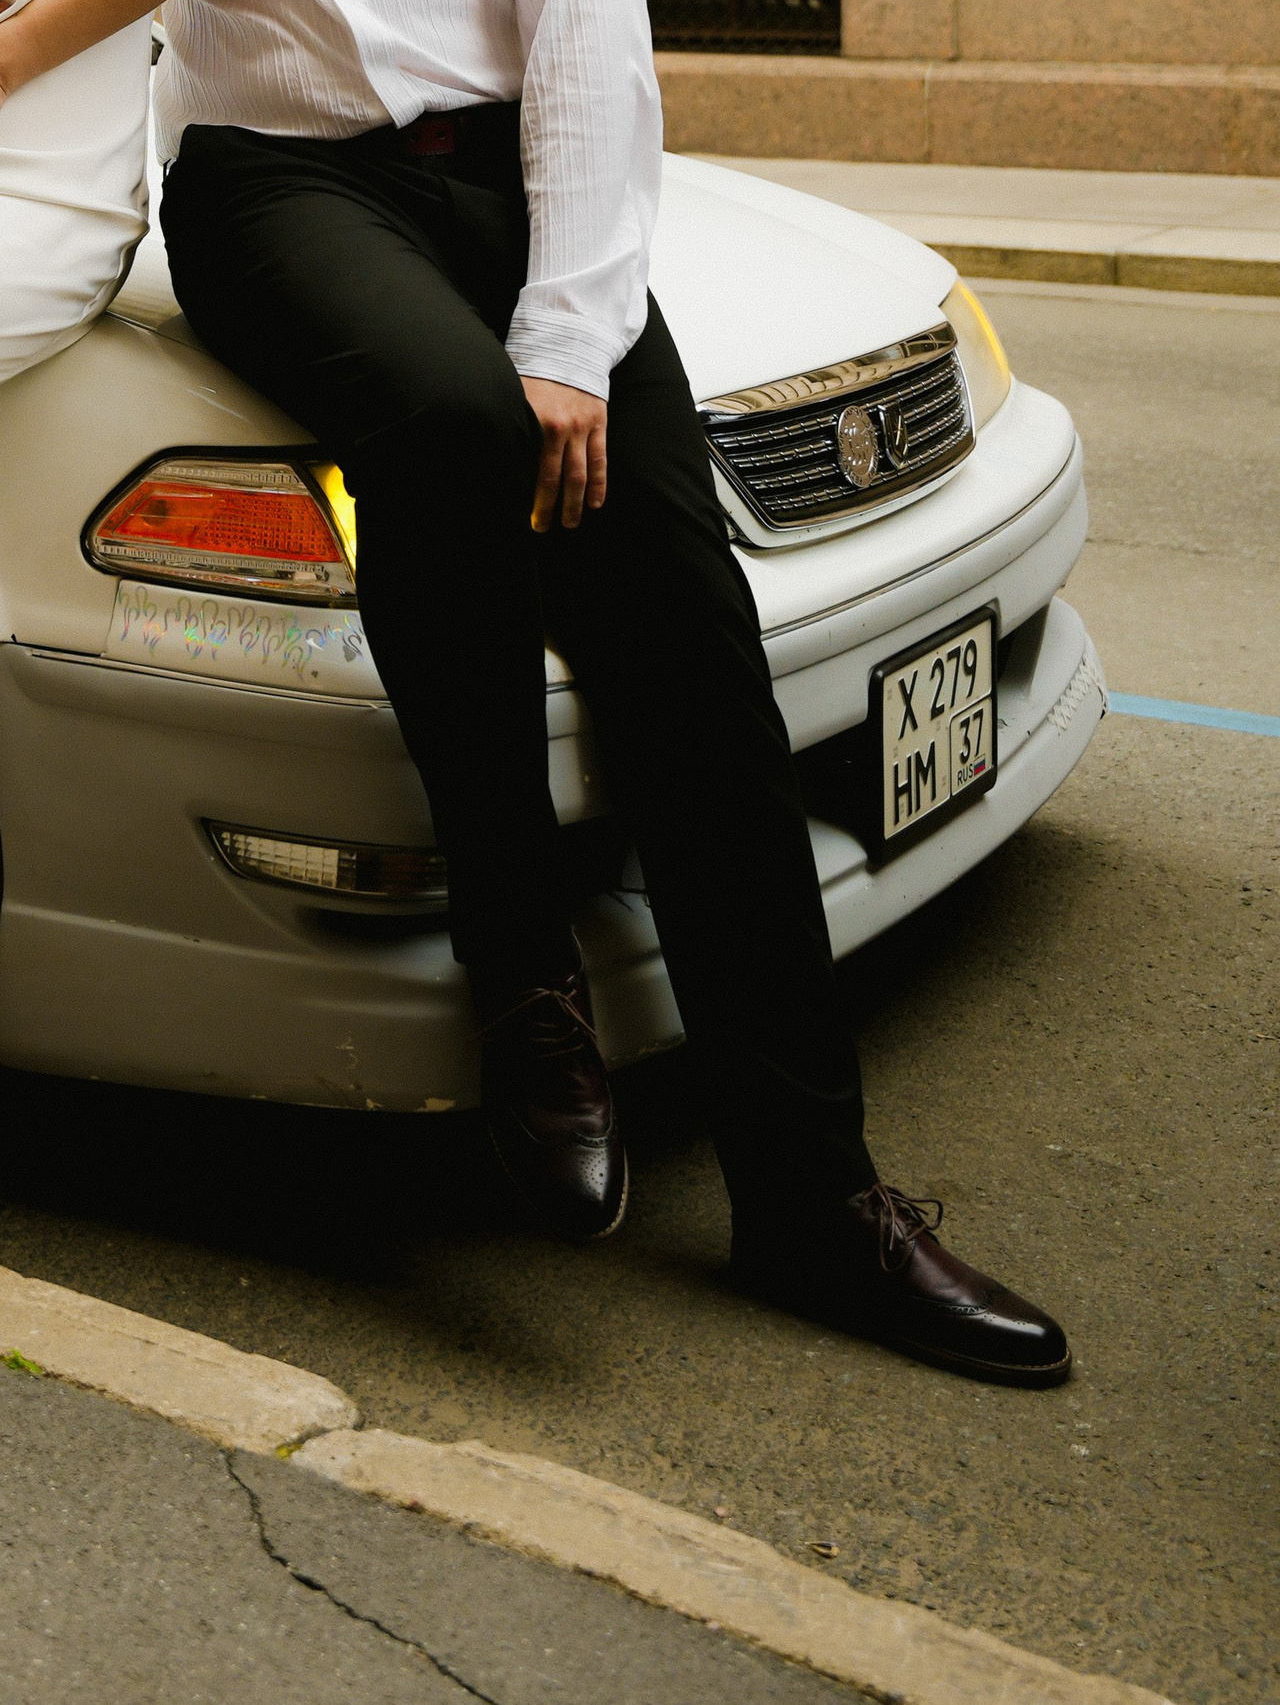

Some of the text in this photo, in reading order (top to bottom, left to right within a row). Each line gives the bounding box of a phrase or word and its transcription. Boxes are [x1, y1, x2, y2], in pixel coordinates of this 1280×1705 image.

[929, 639, 978, 721] 279
[958, 707, 984, 765] 37
[957, 763, 974, 788] RUS
